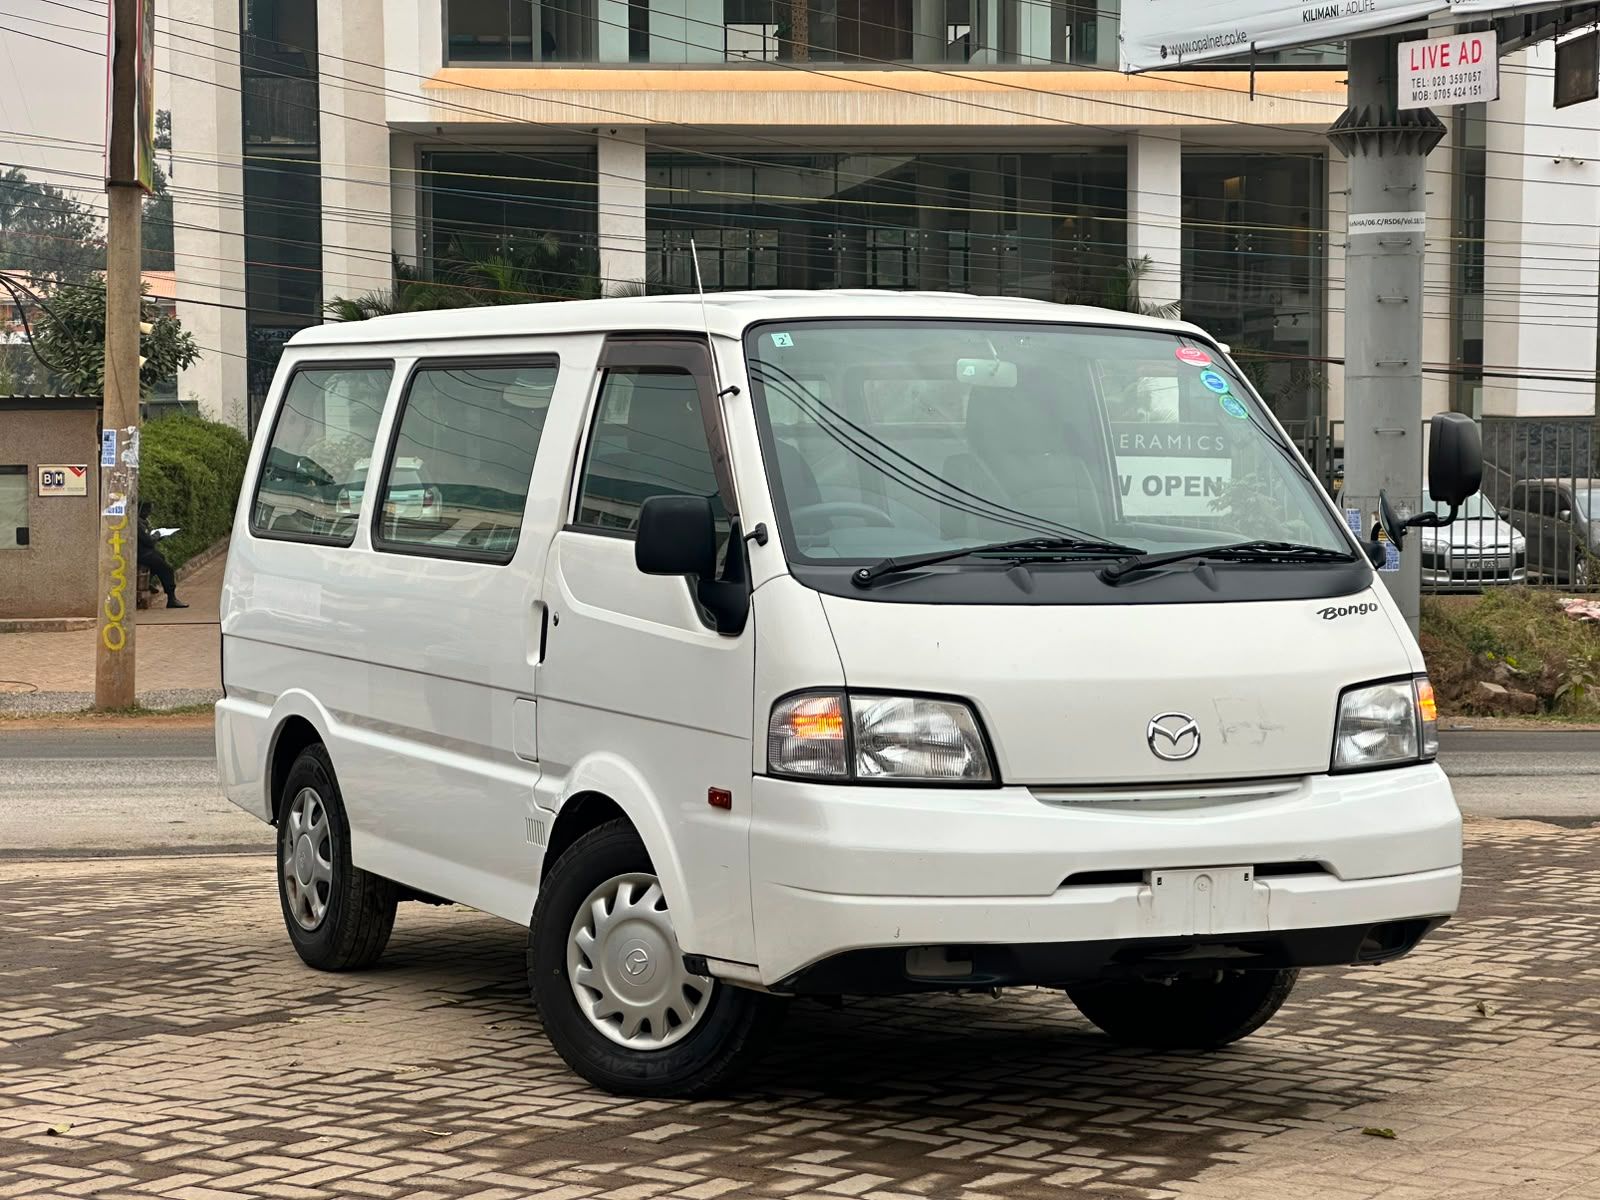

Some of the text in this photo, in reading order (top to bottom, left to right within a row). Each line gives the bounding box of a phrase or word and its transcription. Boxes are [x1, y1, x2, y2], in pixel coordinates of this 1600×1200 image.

[1302, 4, 1339, 22] KILIMANI
[1169, 29, 1248, 56] www.opalnet.co.ke
[1411, 40, 1481, 70] LIVE AD
[1411, 78, 1430, 88] TEL:
[1432, 76, 1447, 87] 020
[1412, 84, 1482, 101] MOB: 0705 424 151
[1119, 433, 1224, 450] ERAMICS
[1142, 475, 1222, 497] OPEN
[1316, 603, 1378, 620] Bongo
